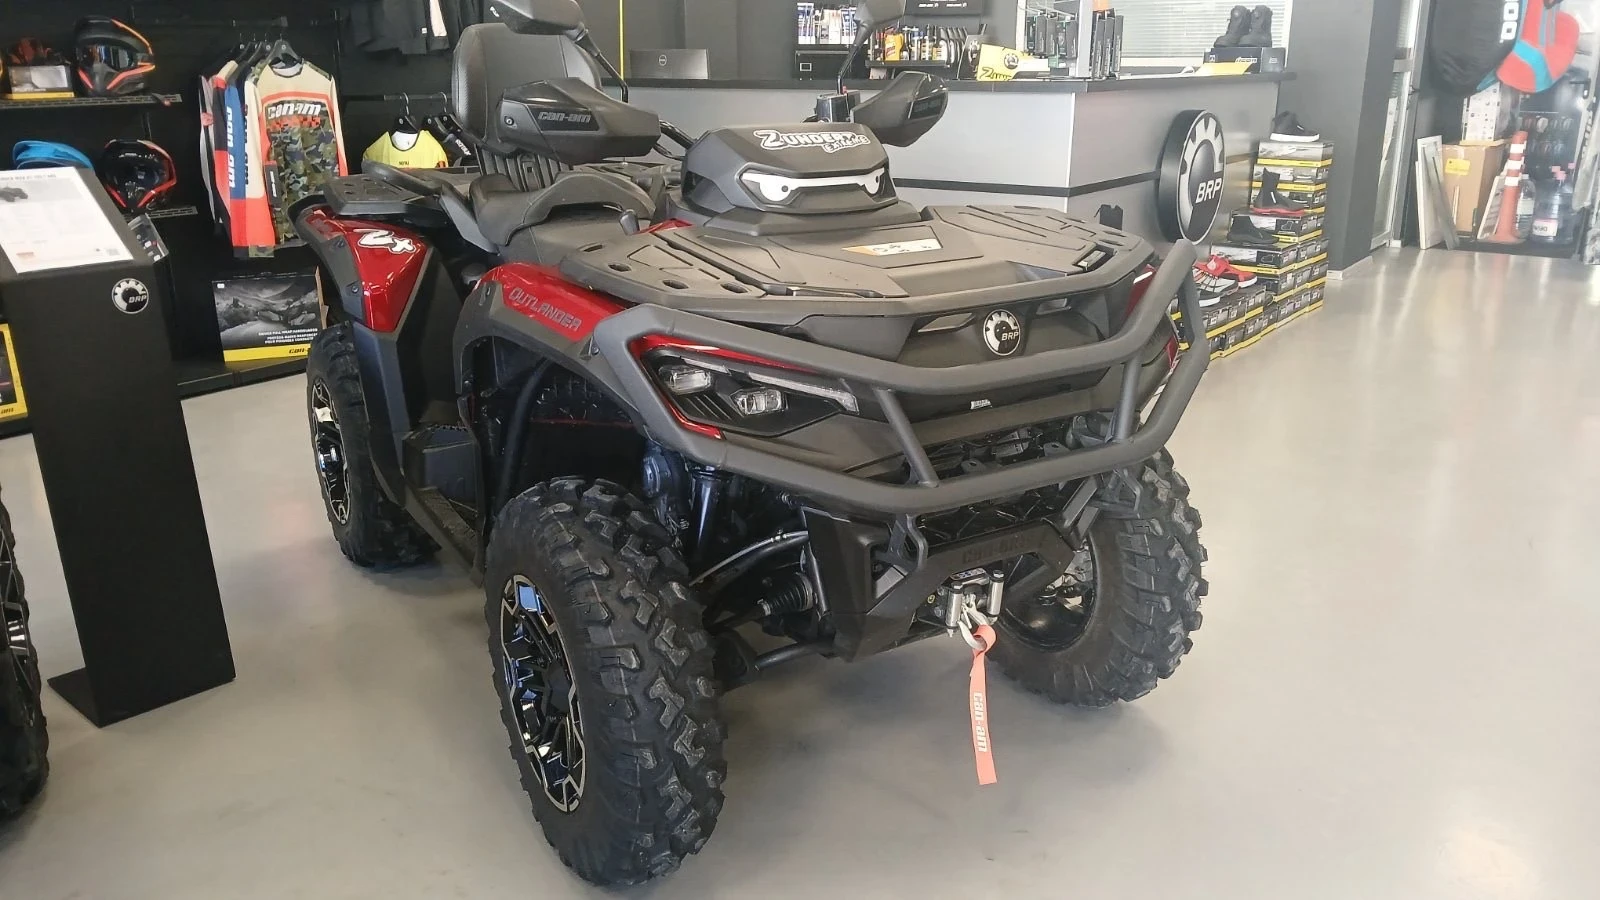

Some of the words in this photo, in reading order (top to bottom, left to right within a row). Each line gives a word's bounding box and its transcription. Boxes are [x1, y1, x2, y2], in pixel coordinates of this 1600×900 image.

[267, 103, 321, 119] can-am
[538, 111, 591, 123] can-am
[1195, 177, 1223, 204] BRP
[508, 286, 582, 331] OUTLANDER
[1001, 329, 1019, 341] BRP
[973, 692, 987, 753] can-am
